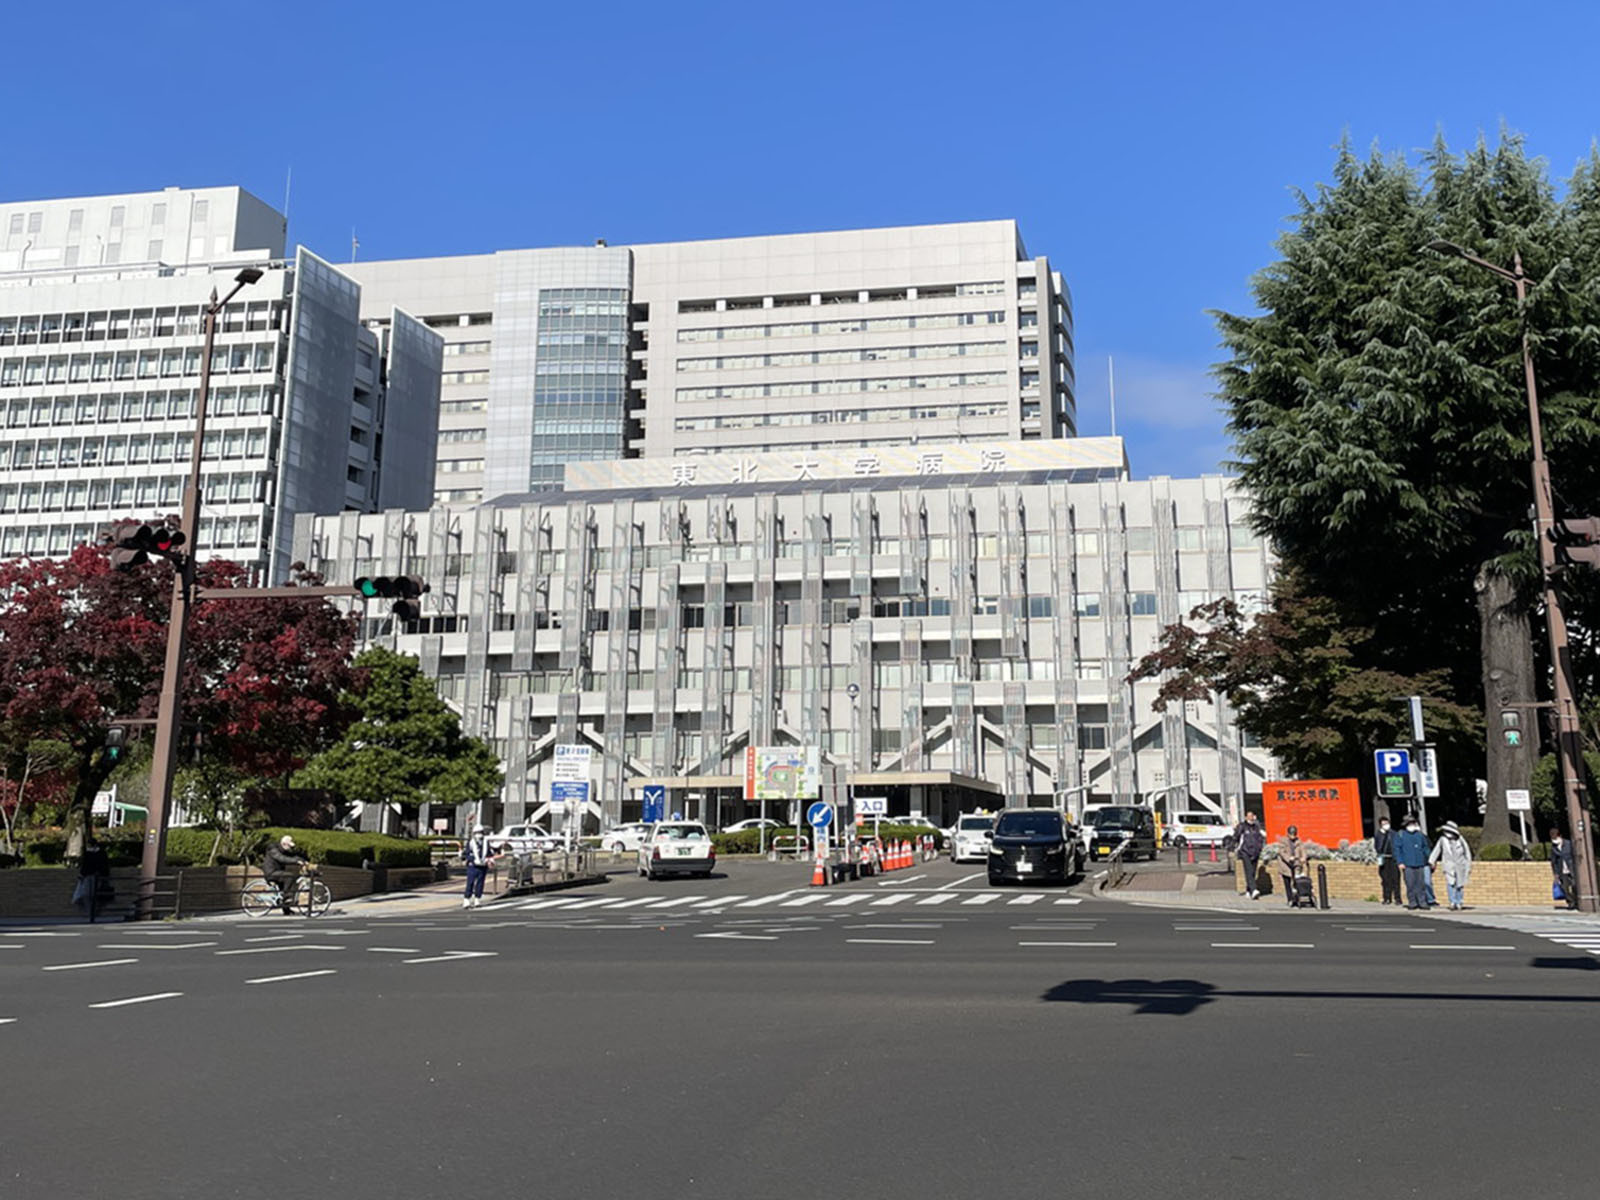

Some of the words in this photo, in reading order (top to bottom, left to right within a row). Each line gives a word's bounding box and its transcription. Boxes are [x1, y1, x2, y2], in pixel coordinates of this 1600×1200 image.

[671, 451, 1007, 486] 東北大学病院
[1384, 753, 1402, 773] P
[1276, 788, 1340, 801] 東北大学病院
[861, 800, 883, 811] 入口
